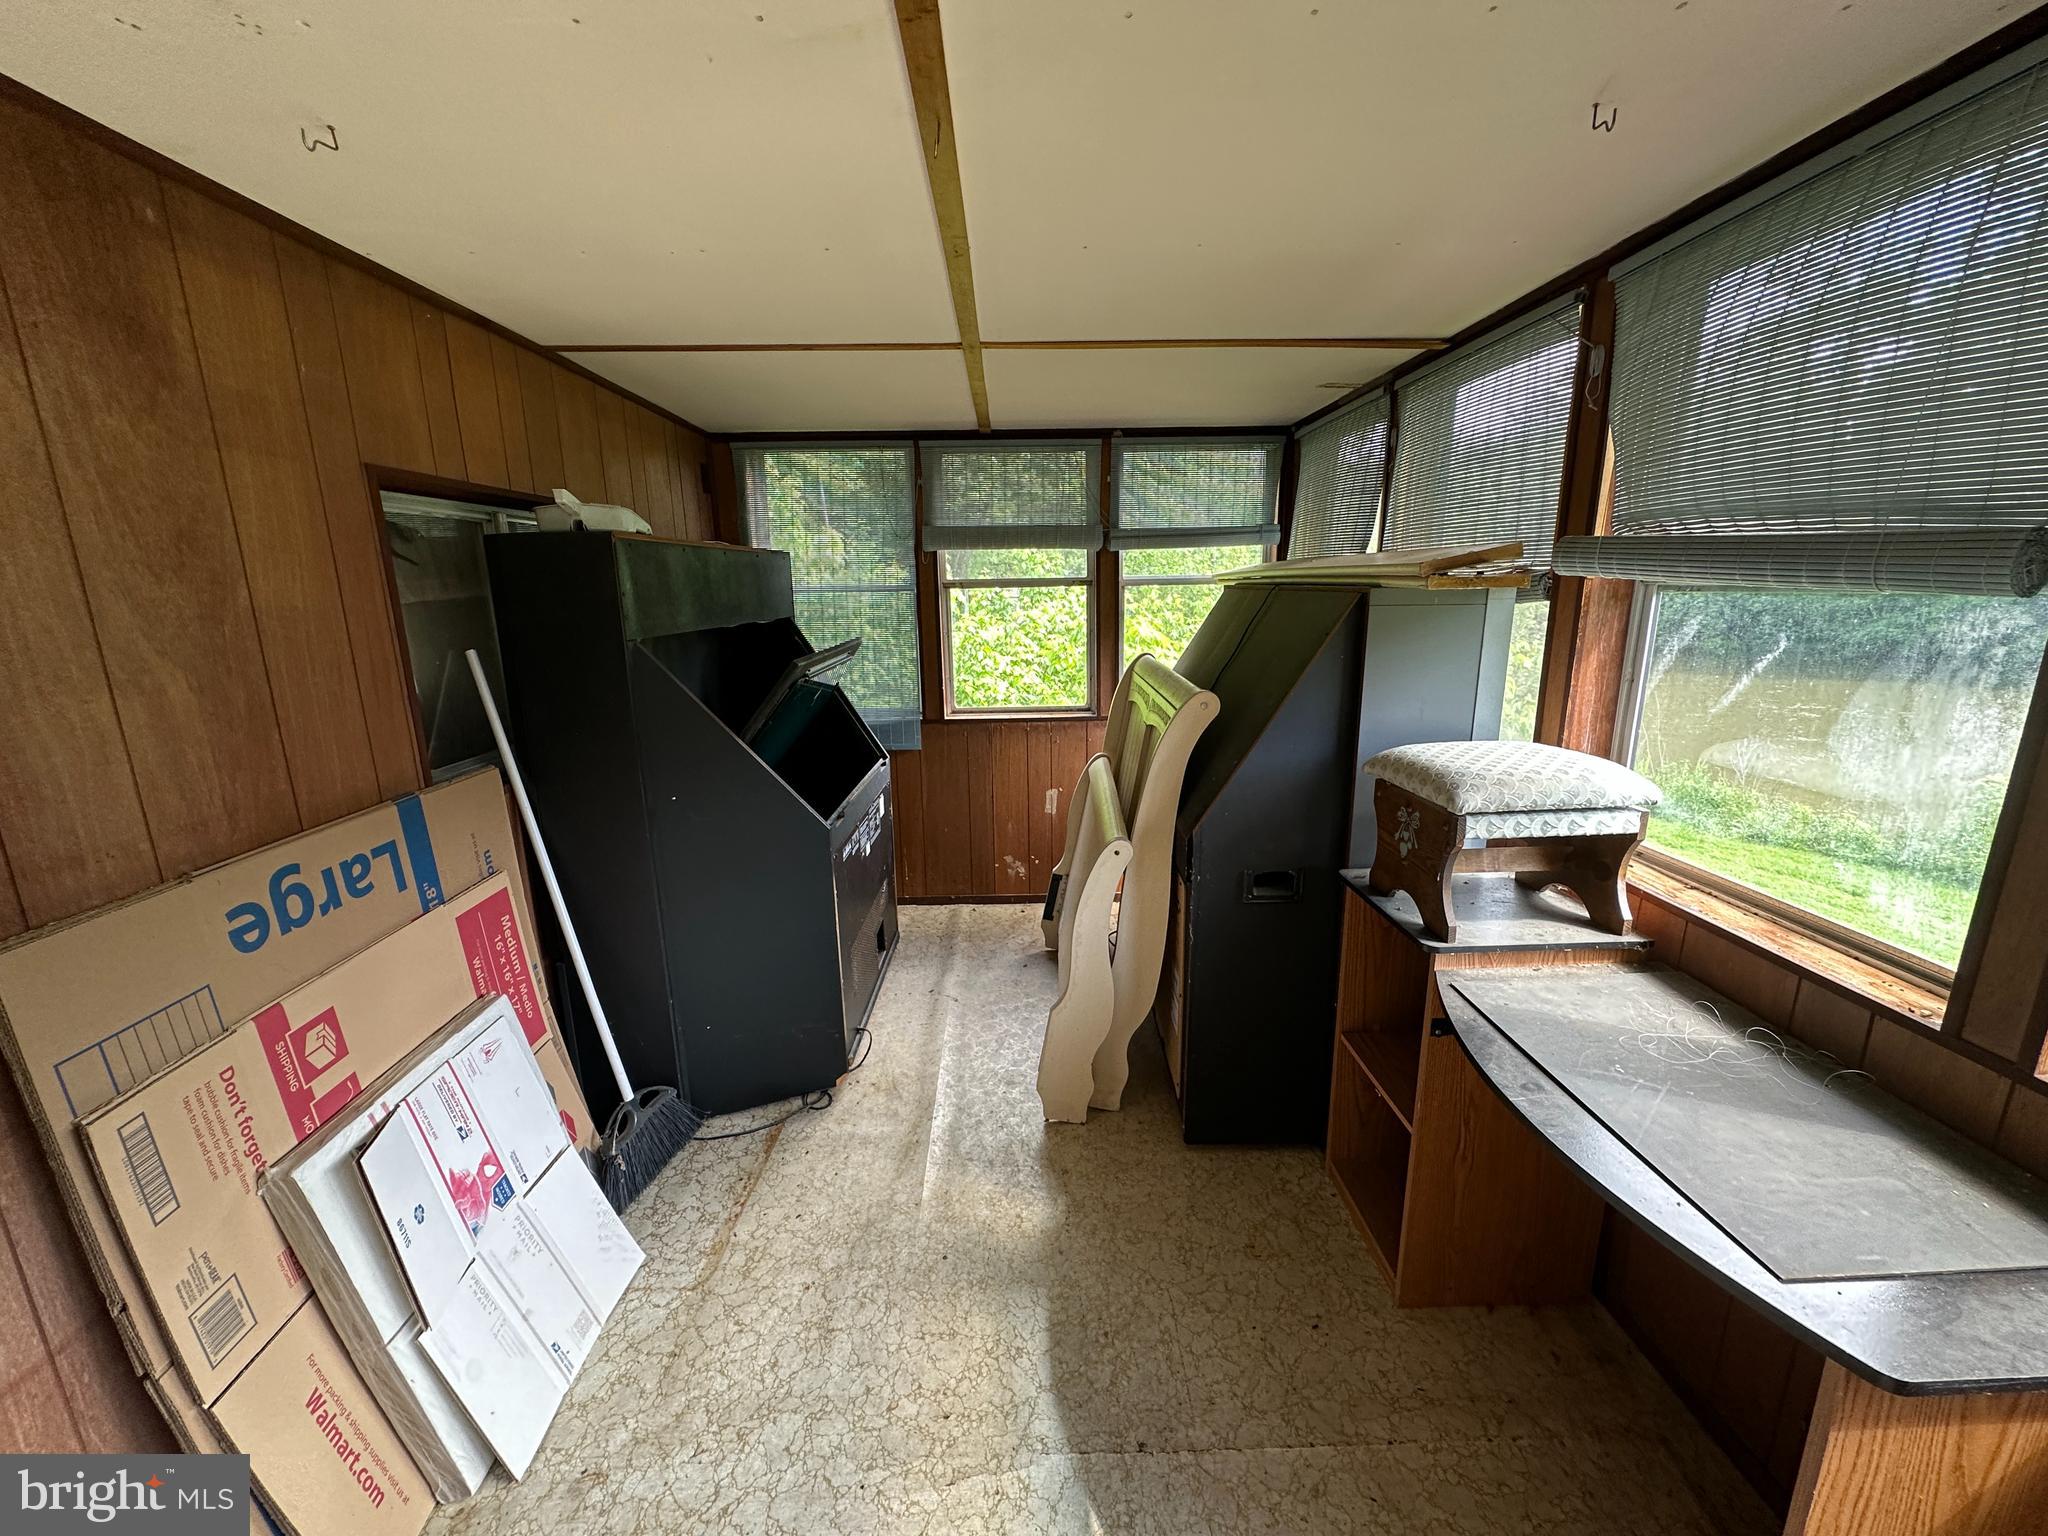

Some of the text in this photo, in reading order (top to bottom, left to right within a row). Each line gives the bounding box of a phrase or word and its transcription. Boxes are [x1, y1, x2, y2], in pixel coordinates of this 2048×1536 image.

[223, 839, 408, 954] Large
[495, 935, 505, 953] 16"
[503, 965, 513, 982] 16"
[511, 995, 522, 1013] 17"
[500, 914, 521, 973] Medium
[519, 984, 533, 1018] Medio
[275, 1041, 299, 1092] SHIPPING
[183, 1096, 218, 1181] tape to seal and secure
[193, 1088, 205, 1110] foam
[201, 1109, 218, 1143] cushion
[217, 1152, 230, 1176] dishes
[204, 1080, 219, 1110] bubble
[215, 1109, 230, 1139] cushion
[230, 1150, 244, 1174] fragile
[239, 1172, 251, 1195] items
[219, 1065, 268, 1173] Don't forget
[515, 1215, 544, 1253] PRIORITY
[516, 1230, 531, 1253] MAIL
[471, 1275, 498, 1311] PRIORITY
[305, 1386, 386, 1508] Walmart.com
[306, 1353, 410, 1505] For more packing & shipping supplies visit us at
